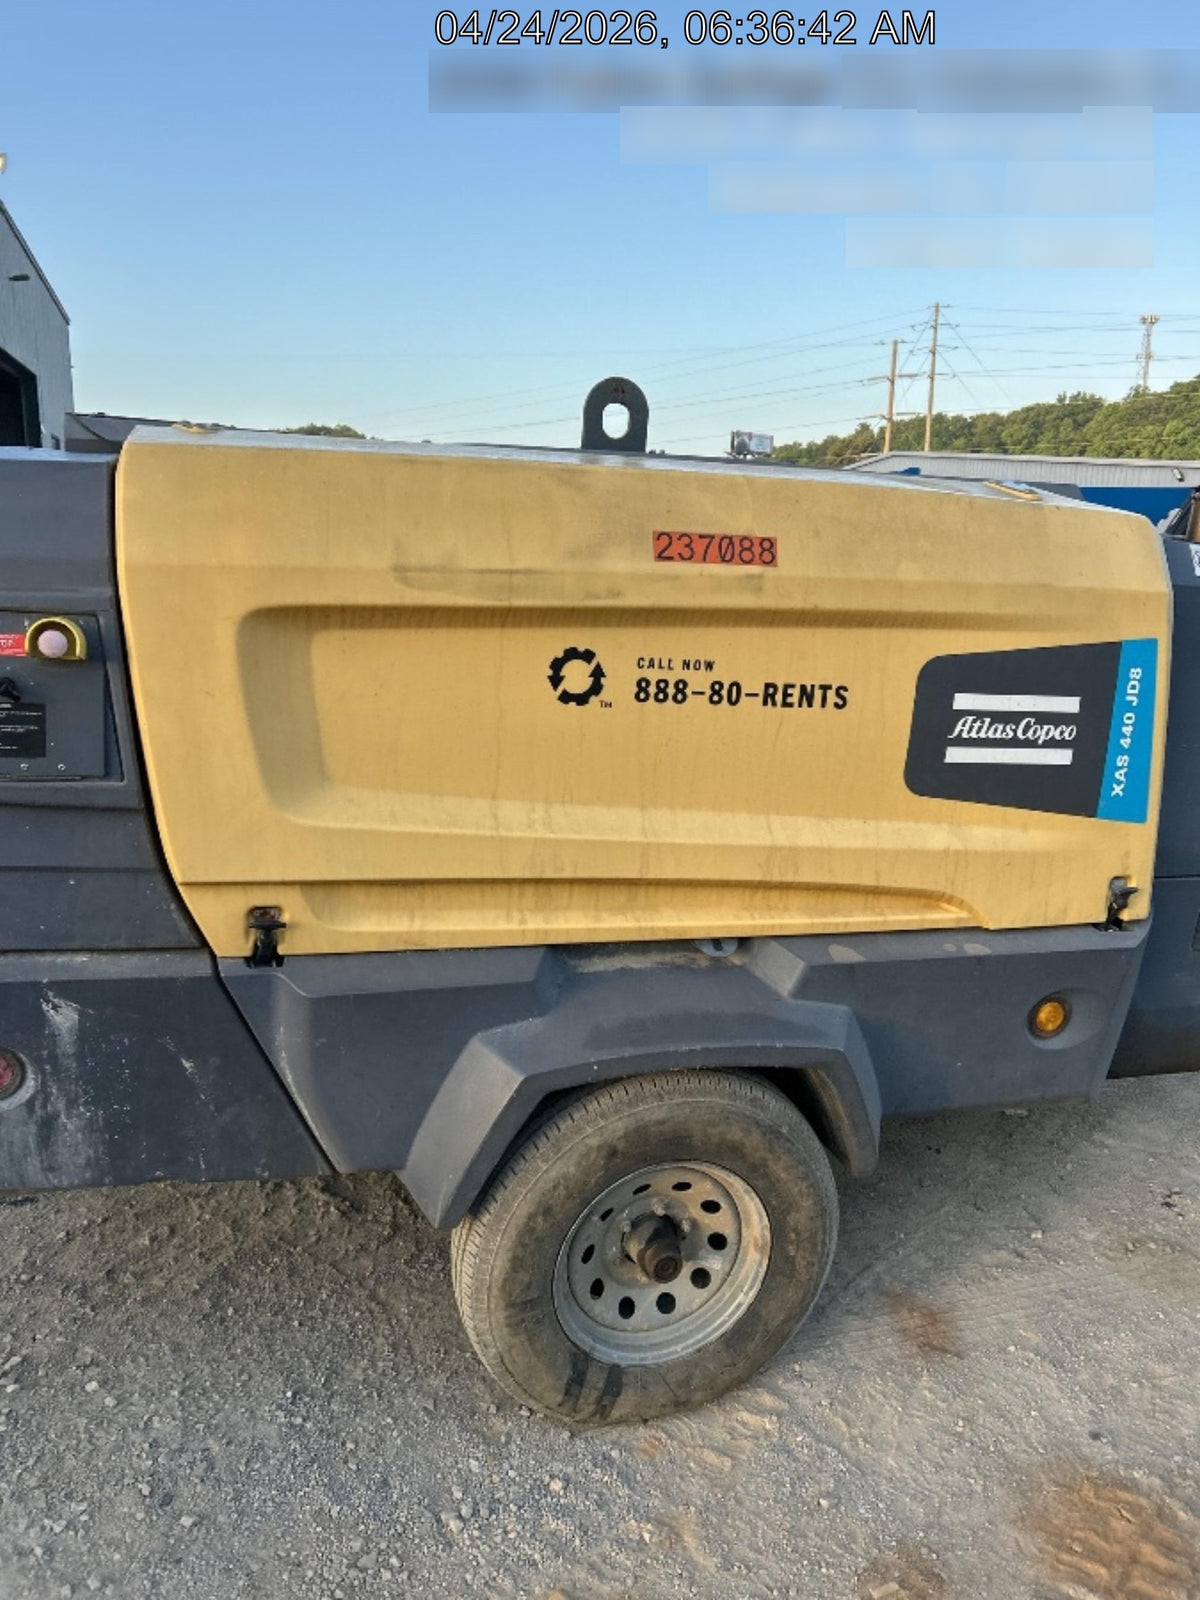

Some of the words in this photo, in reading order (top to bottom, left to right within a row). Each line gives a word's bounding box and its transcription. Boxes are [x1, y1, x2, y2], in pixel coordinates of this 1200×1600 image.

[656, 532, 776, 565] 237088
[637, 657, 674, 671] CALL
[682, 659, 715, 673] NOW
[634, 677, 849, 710] 888-80-RENTS
[1126, 667, 1143, 707] JD8
[1120, 712, 1136, 749] 440
[1111, 754, 1130, 797] XAS
